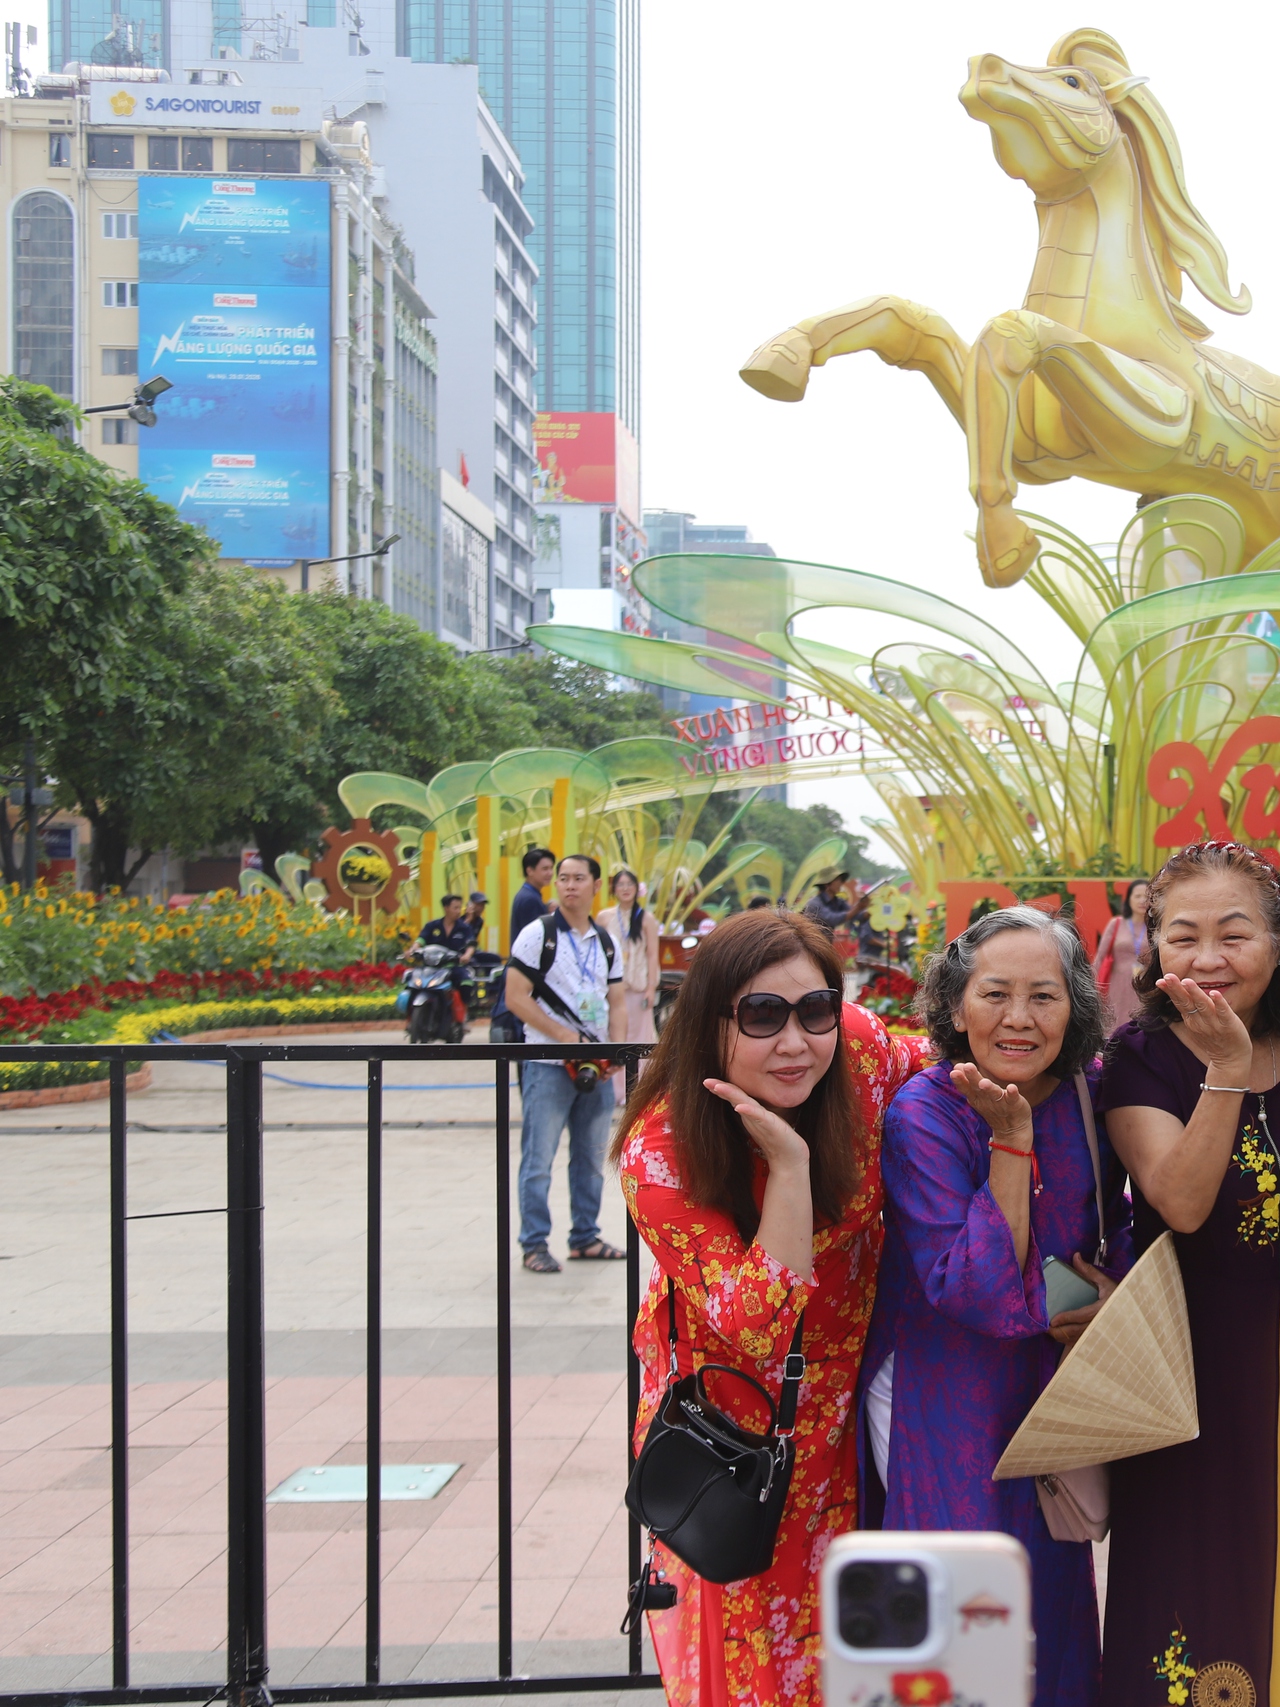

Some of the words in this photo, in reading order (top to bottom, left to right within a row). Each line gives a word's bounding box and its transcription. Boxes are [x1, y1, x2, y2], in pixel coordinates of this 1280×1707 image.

[145, 97, 261, 115] SAIGONTOURIST
[271, 105, 300, 116] GROUP
[273, 219, 290, 228] GIA
[237, 325, 272, 340] PHÁT
[273, 322, 315, 340] TRIỂN
[207, 343, 252, 358] LƯỢNG
[254, 341, 290, 356] QUỐC
[292, 344, 317, 356] GIA
[670, 706, 755, 746] XUÂN
[678, 741, 767, 780] VỮNG
[776, 726, 864, 763] BƯỚC
